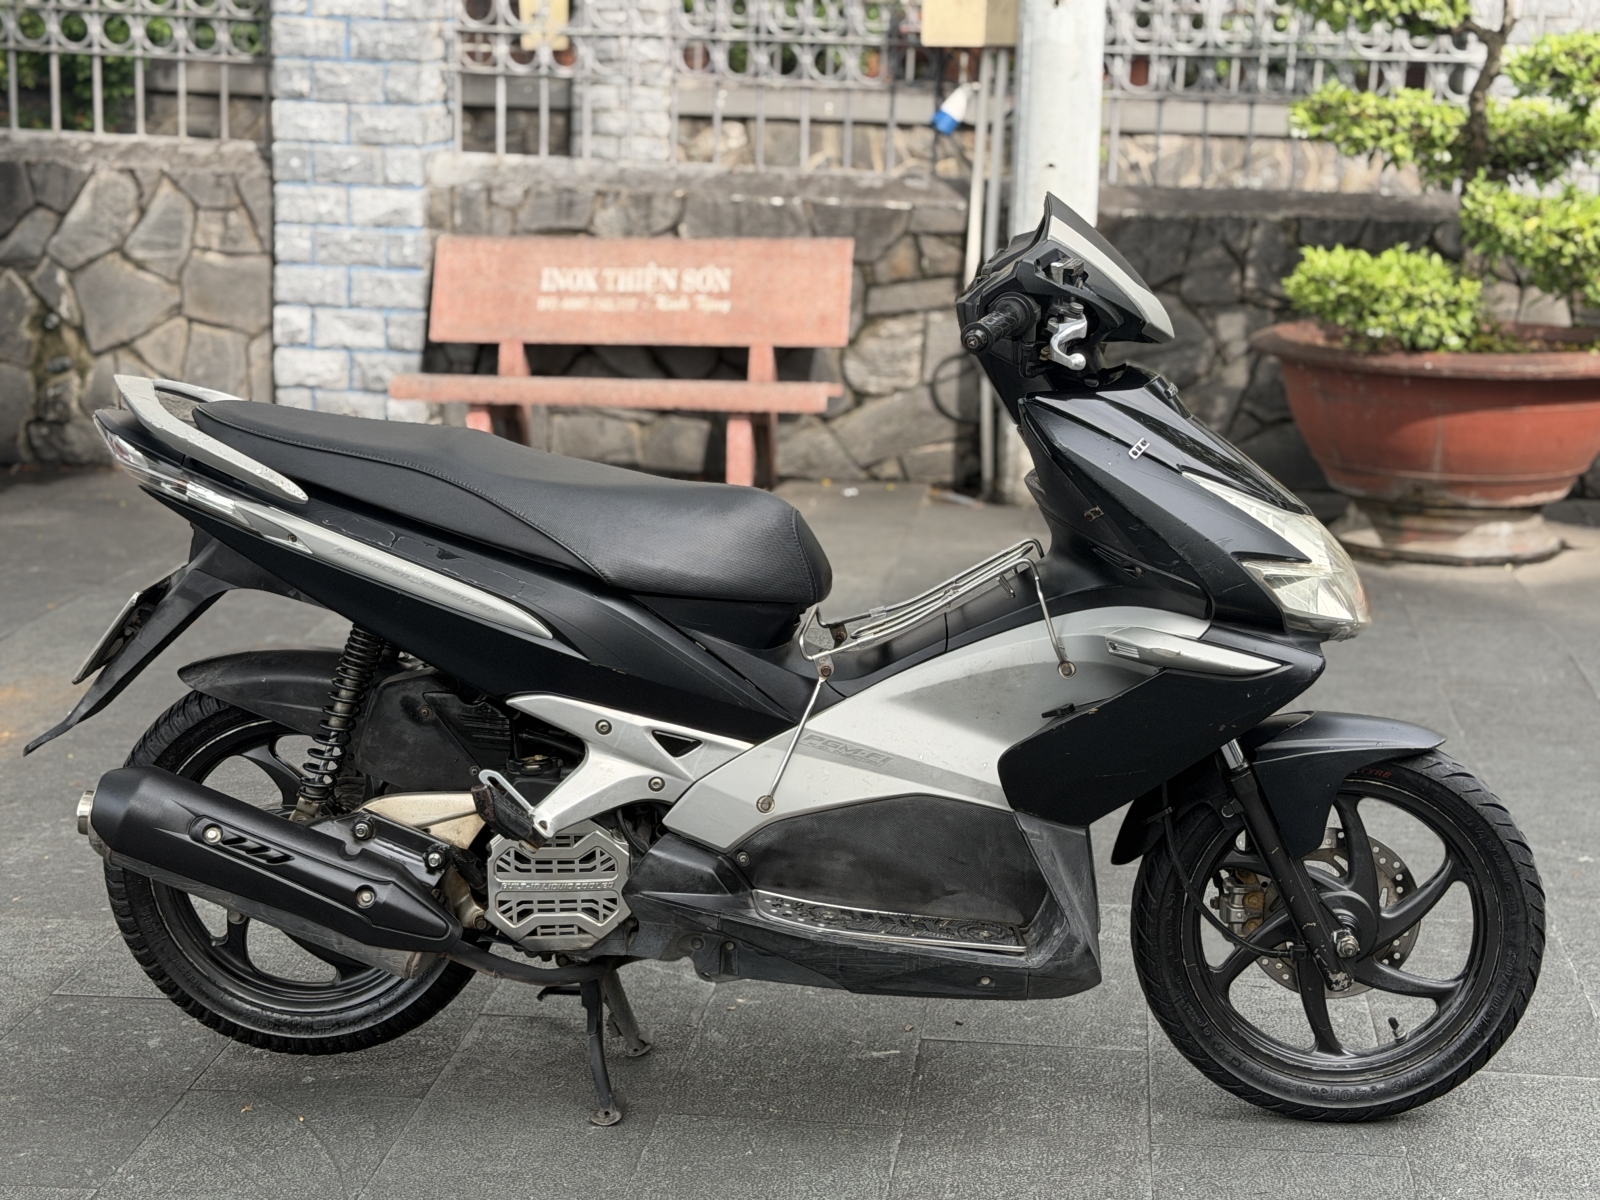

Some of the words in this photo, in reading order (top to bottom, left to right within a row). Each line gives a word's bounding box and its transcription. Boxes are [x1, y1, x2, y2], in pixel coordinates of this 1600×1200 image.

[540, 267, 598, 292] INOX
[680, 264, 732, 293] SƠN
[501, 882, 540, 890] BUILT-IN
[542, 882, 574, 890] LIQUID
[575, 881, 614, 890] COOLED
